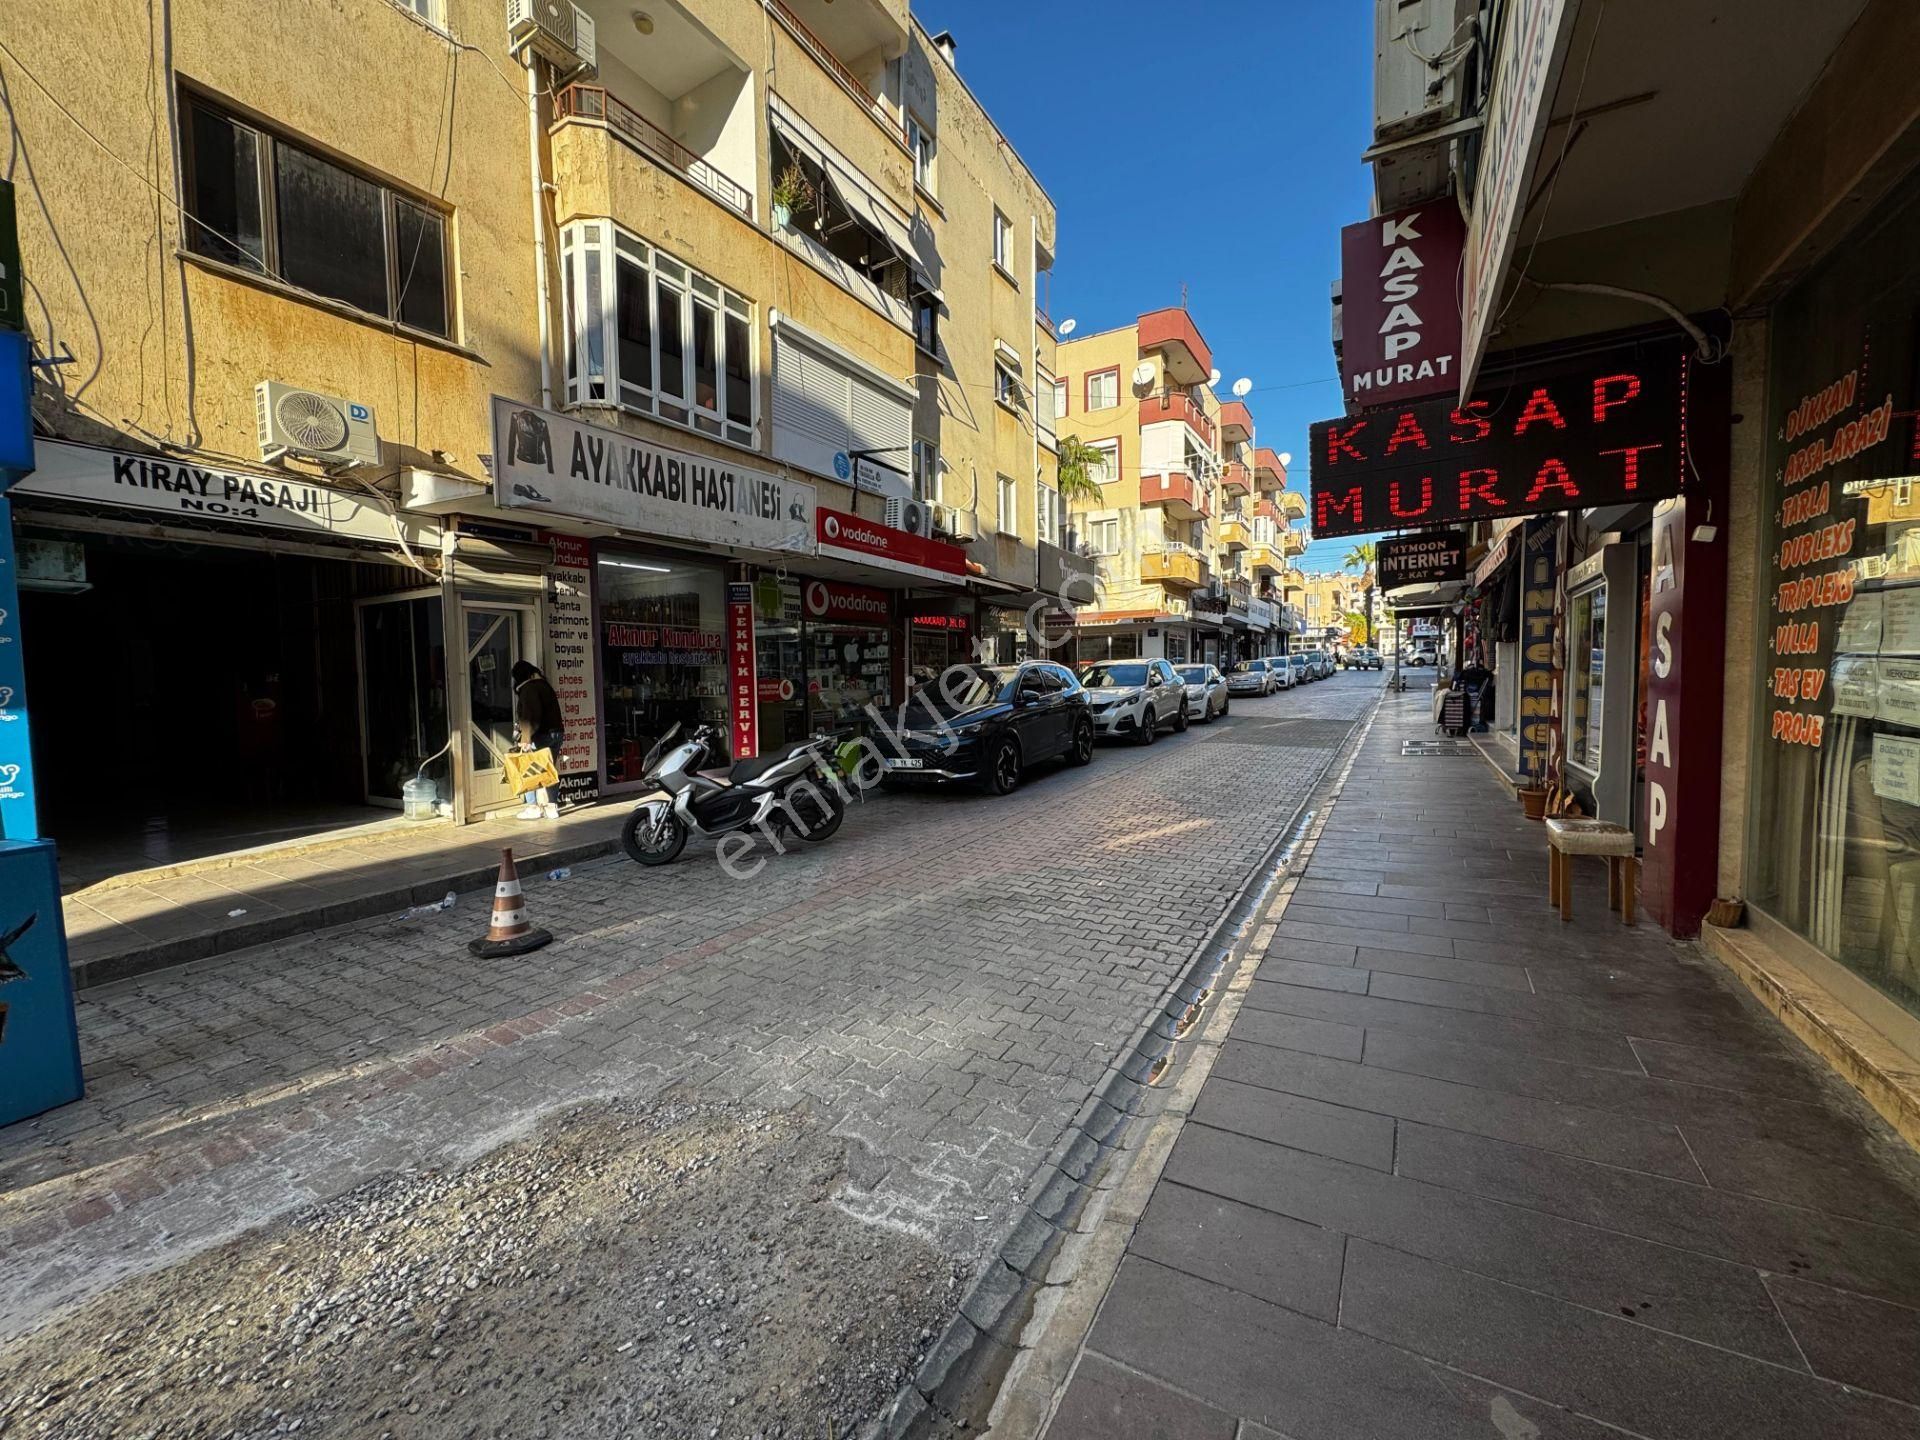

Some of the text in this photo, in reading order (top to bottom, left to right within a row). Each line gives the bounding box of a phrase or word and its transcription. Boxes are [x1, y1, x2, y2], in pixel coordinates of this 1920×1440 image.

[1378, 212, 1425, 361] KASAP
[1353, 355, 1452, 393] MURAT
[1786, 369, 1857, 443] DÜKKAN
[1328, 374, 1641, 466] KASAP
[1784, 393, 1893, 487] ARSA-ARAZİ
[570, 430, 686, 502] AYAKKABI
[112, 455, 319, 514] KIRAY PASAJI
[1317, 443, 1662, 528] MURAT
[181, 498, 259, 519] NO:4
[1782, 480, 1830, 528] TARLA
[549, 536, 582, 552] Aknur
[842, 526, 888, 549] vodafone
[1390, 541, 1447, 554] MYMOON
[1780, 518, 1856, 570] DUBLEXS
[546, 571, 586, 584] ayakkabı
[1408, 570, 1429, 579] KAT
[1778, 568, 1856, 613] TRİPLEXS
[554, 602, 581, 613] çanta
[829, 593, 887, 614] vodafone
[549, 628, 588, 640] tamir ve
[607, 624, 722, 649] Aknur Kundura
[1776, 618, 1819, 655] VİLLA
[554, 642, 584, 655] boyası
[556, 657, 584, 670] yapılır
[558, 674, 583, 685] shoes
[1649, 520, 1676, 847] ASAP
[1774, 667, 1825, 705] TAŞ EV
[555, 688, 588, 701] slippers
[565, 703, 580, 714] bag
[580, 729, 594, 740] and
[1772, 709, 1825, 747] PROJE
[570, 758, 589, 770] done
[559, 776, 592, 790] Aknur
